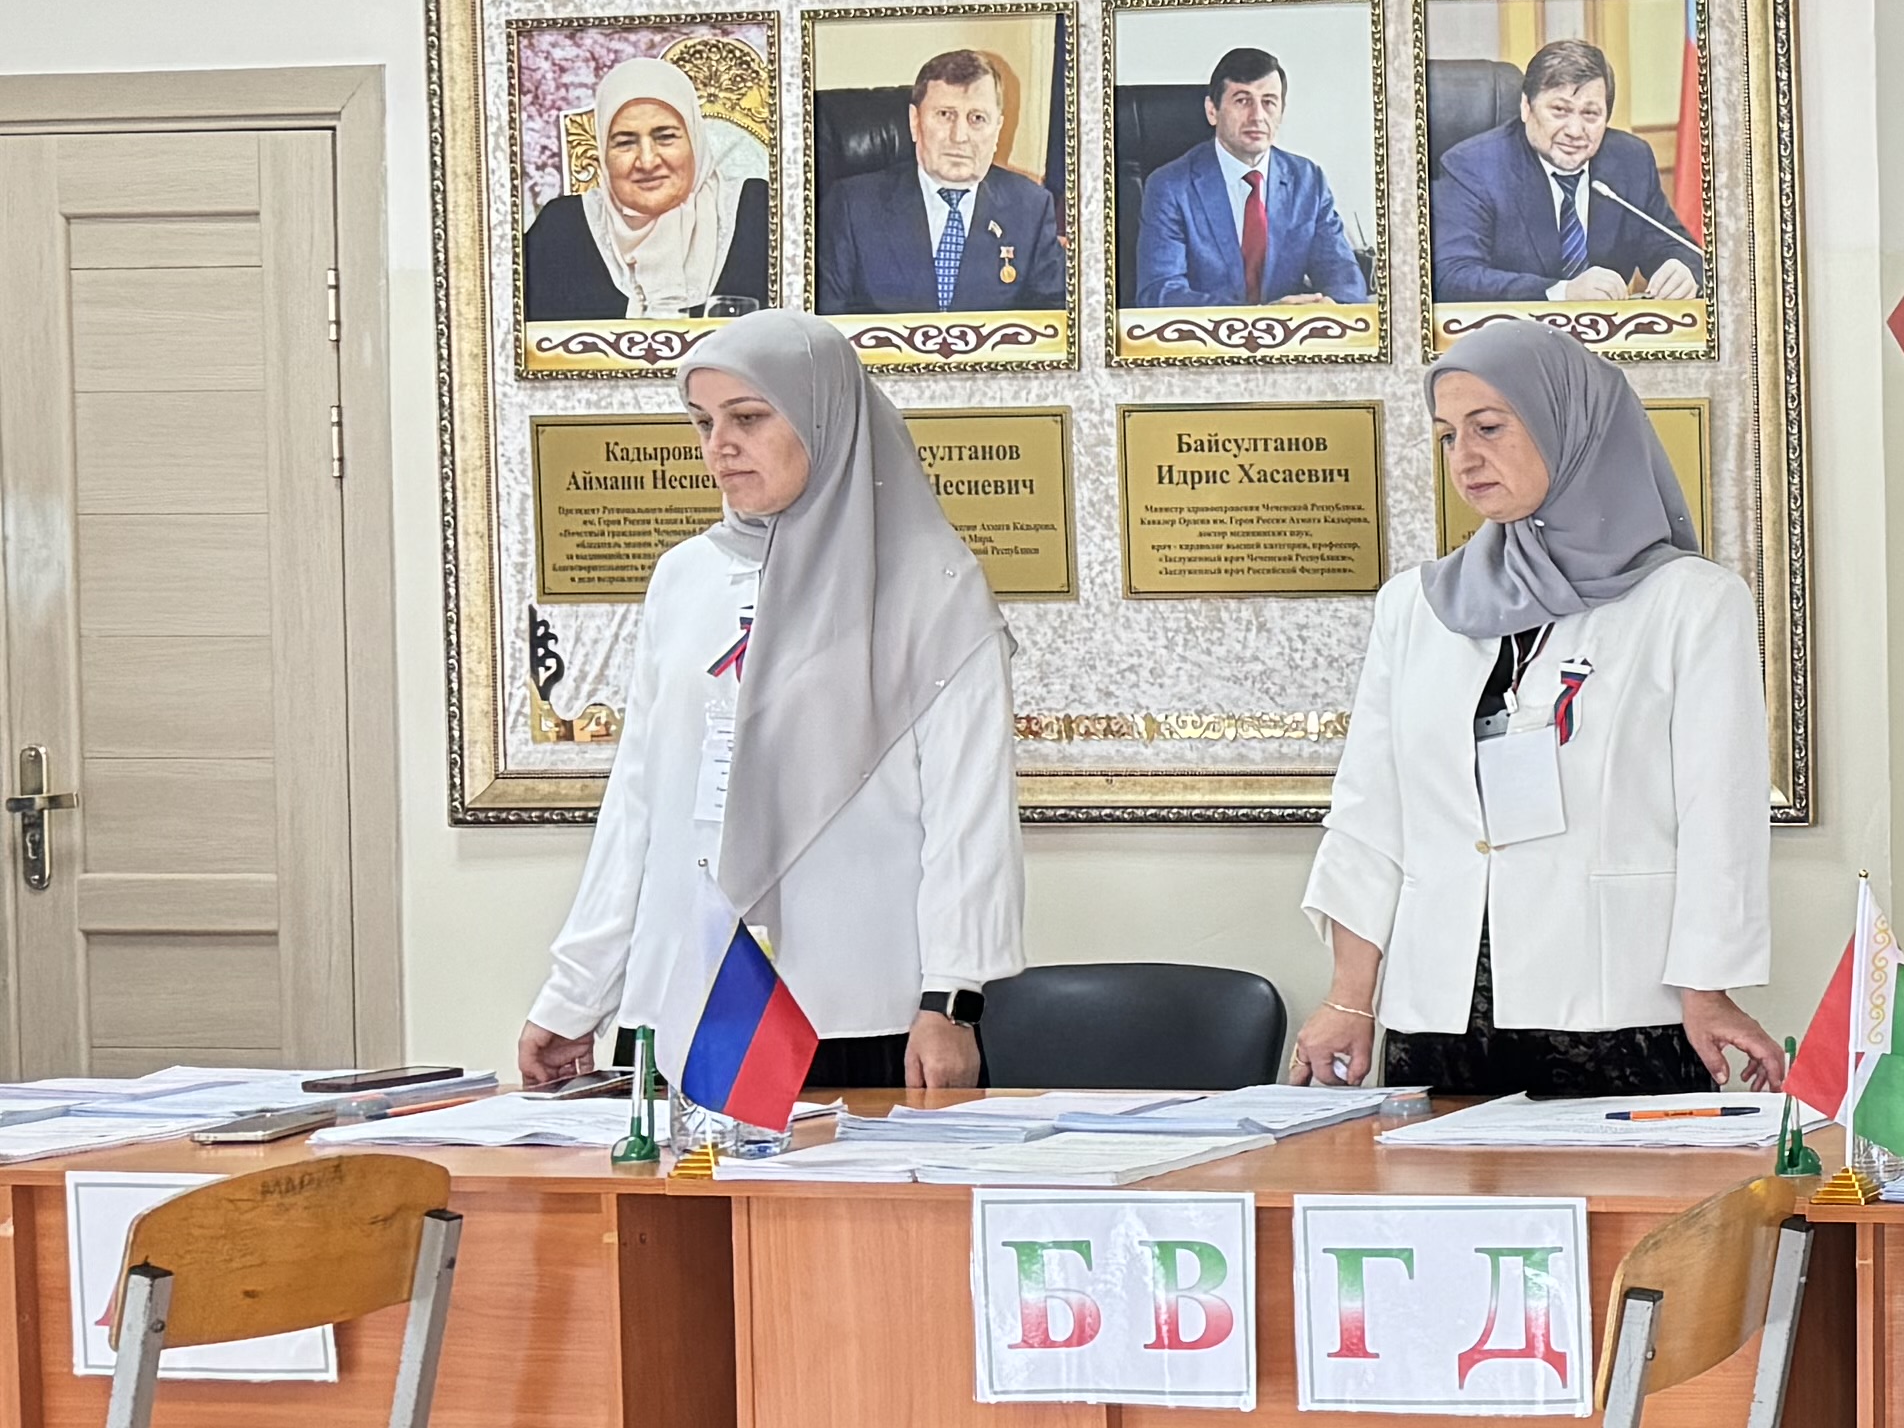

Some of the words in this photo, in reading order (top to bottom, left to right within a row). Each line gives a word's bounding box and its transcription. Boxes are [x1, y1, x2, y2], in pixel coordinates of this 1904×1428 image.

[604, 441, 703, 466] Кадырова
[916, 444, 1022, 467] султанов
[1176, 432, 1328, 458] Байсултанов
[566, 471, 645, 491] Аймани
[652, 469, 720, 491] Несие
[1156, 464, 1231, 490] Идрис
[1237, 462, 1350, 485] Хасаевич
